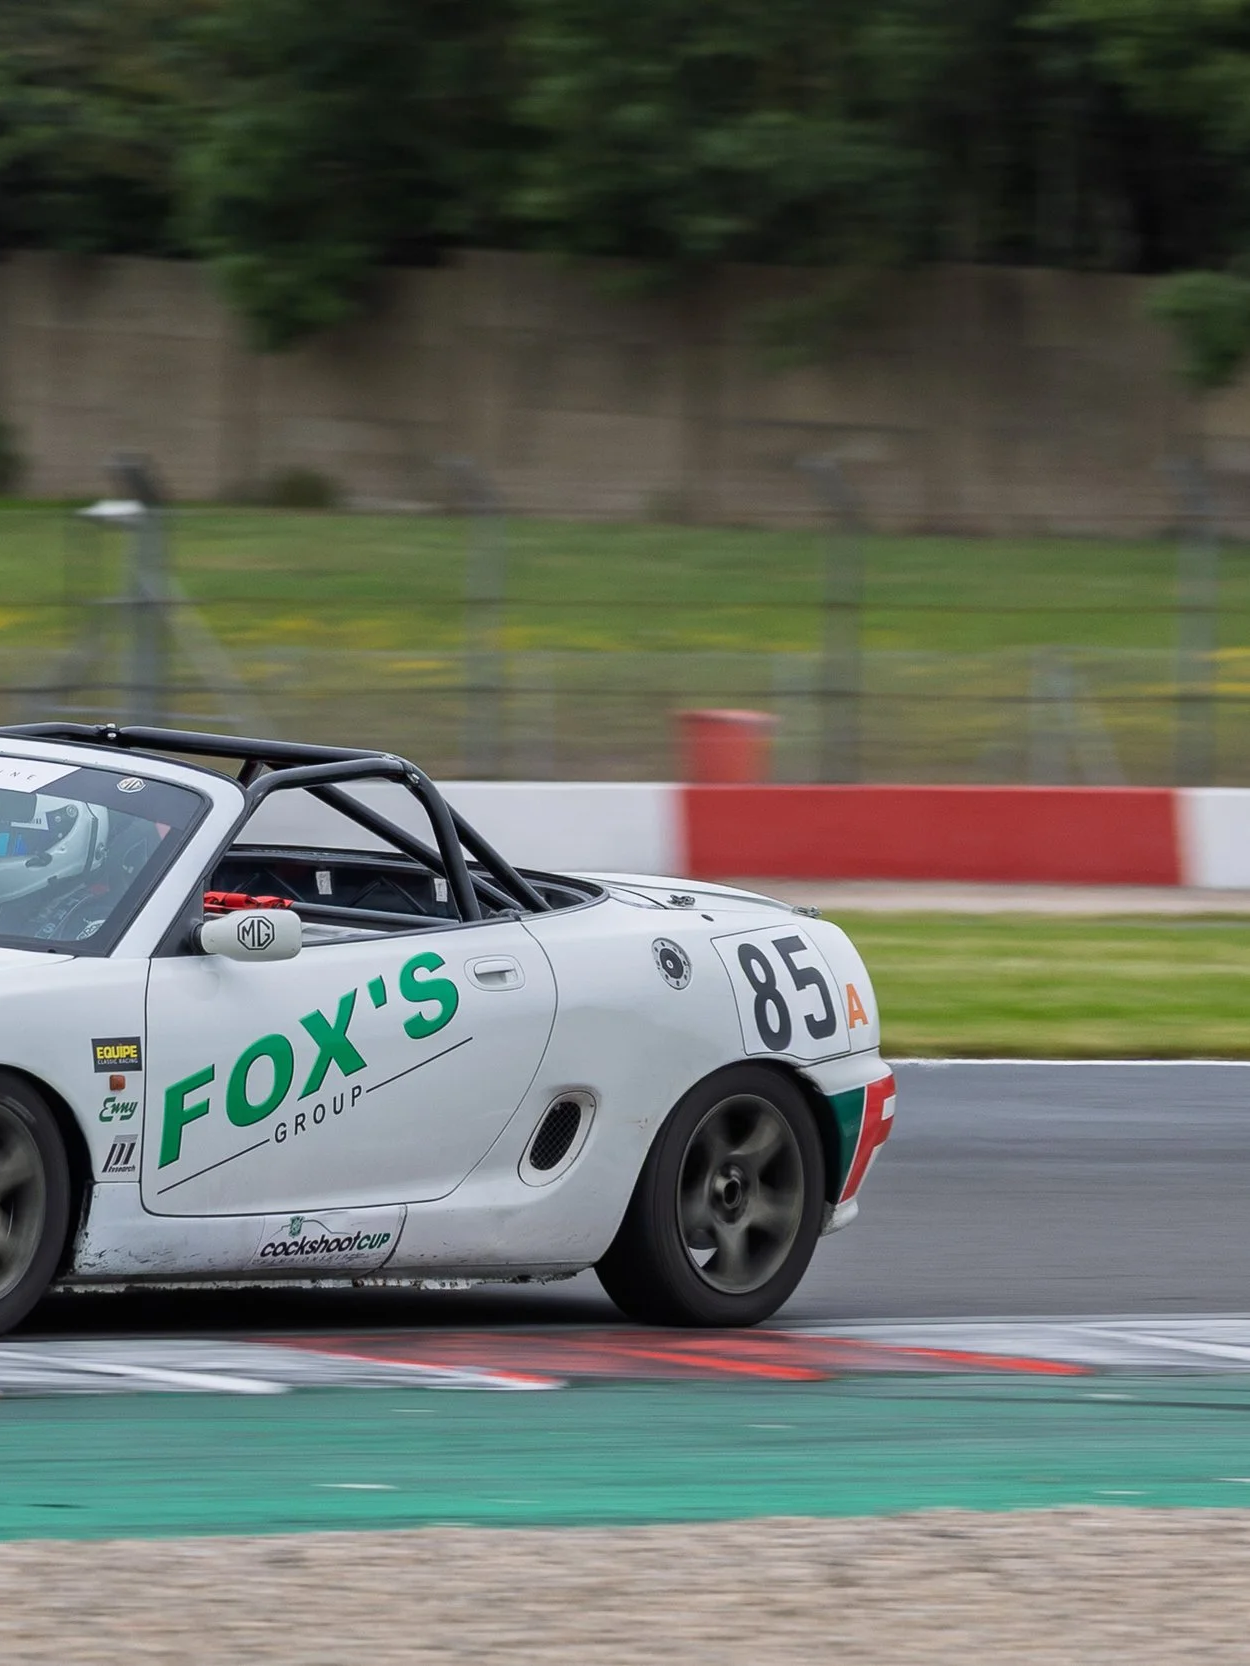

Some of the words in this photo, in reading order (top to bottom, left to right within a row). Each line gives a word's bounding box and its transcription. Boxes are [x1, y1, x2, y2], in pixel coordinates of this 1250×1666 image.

[242, 923, 274, 947] MG
[738, 935, 836, 1051] 85
[846, 983, 868, 1028] A
[96, 1045, 138, 1059] EQUIPE
[158, 952, 459, 1170] FOX'S
[99, 1097, 139, 1123] Enny
[275, 1085, 362, 1143] GROUP
